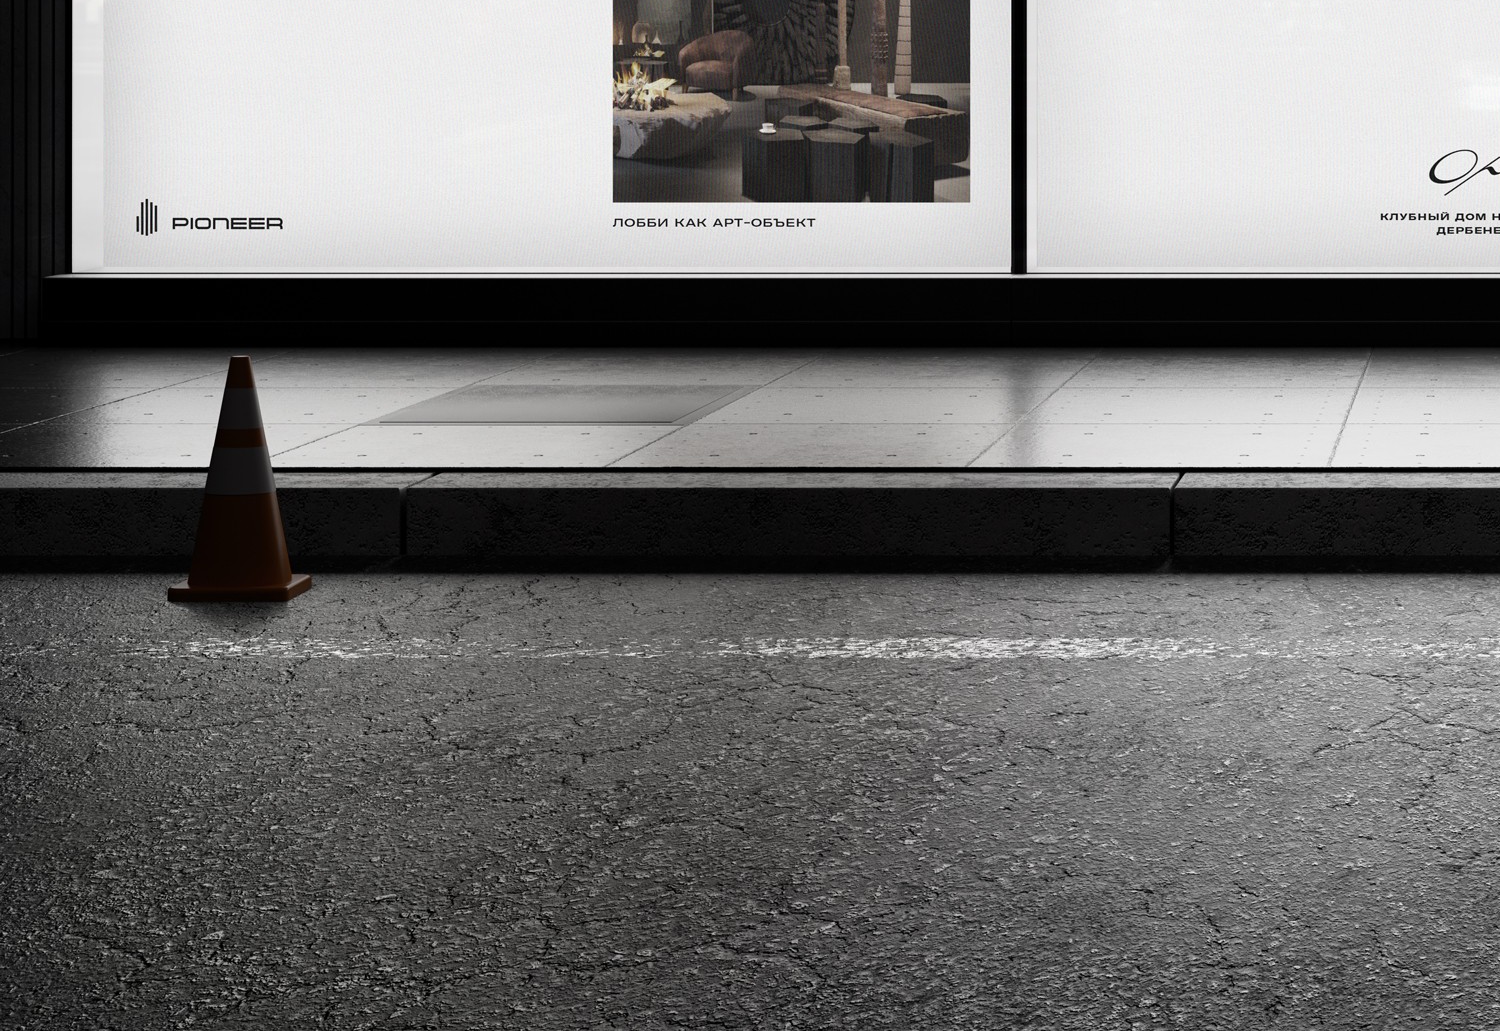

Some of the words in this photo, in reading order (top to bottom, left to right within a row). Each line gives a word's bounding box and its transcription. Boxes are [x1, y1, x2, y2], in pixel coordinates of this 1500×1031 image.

[612, 217, 669, 228] ЛОББИ
[674, 217, 707, 228] КАК
[712, 217, 817, 228] АРТ-ОБЪЕКТ
[1380, 211, 1450, 221] КЛУБНЫЙ
[1454, 212, 1487, 223] ДОМ
[171, 217, 284, 230] PIONEER
